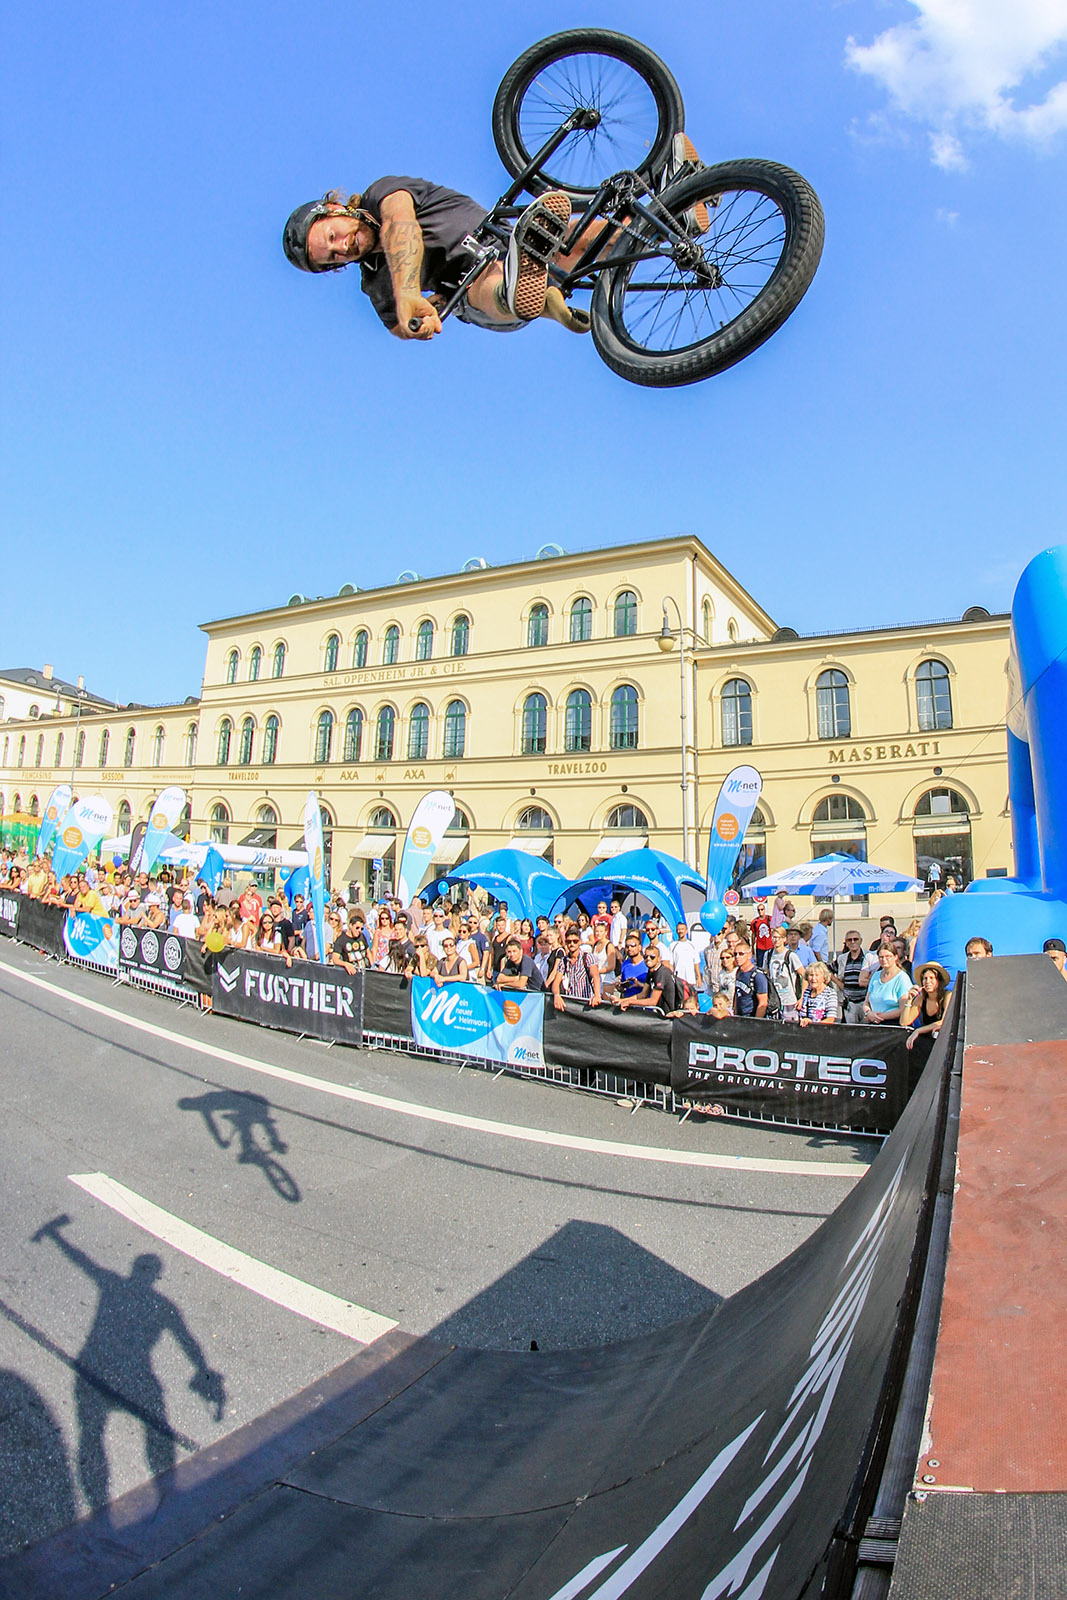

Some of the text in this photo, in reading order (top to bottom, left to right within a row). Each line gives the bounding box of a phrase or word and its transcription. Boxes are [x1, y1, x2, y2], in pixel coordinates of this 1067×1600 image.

[323, 677, 342, 687] SAL.
[344, 668, 406, 684] OPPENHEIM
[410, 665, 427, 677] JR.
[443, 662, 466, 673] CIE.
[828, 741, 941, 763] MASERATI
[403, 769, 426, 780] AXA
[547, 761, 608, 775] TRAVELZOO
[101, 772, 125, 781] SASSOON
[228, 772, 260, 781] TRAVELZOO
[339, 770, 359, 781] AXA
[244, 968, 355, 1018] FURTHER
[455, 1007, 473, 1016] neuer
[688, 1041, 888, 1084] PRO-TEC
[687, 1069, 887, 1100] THE ORIGINAL SINCE 1973
